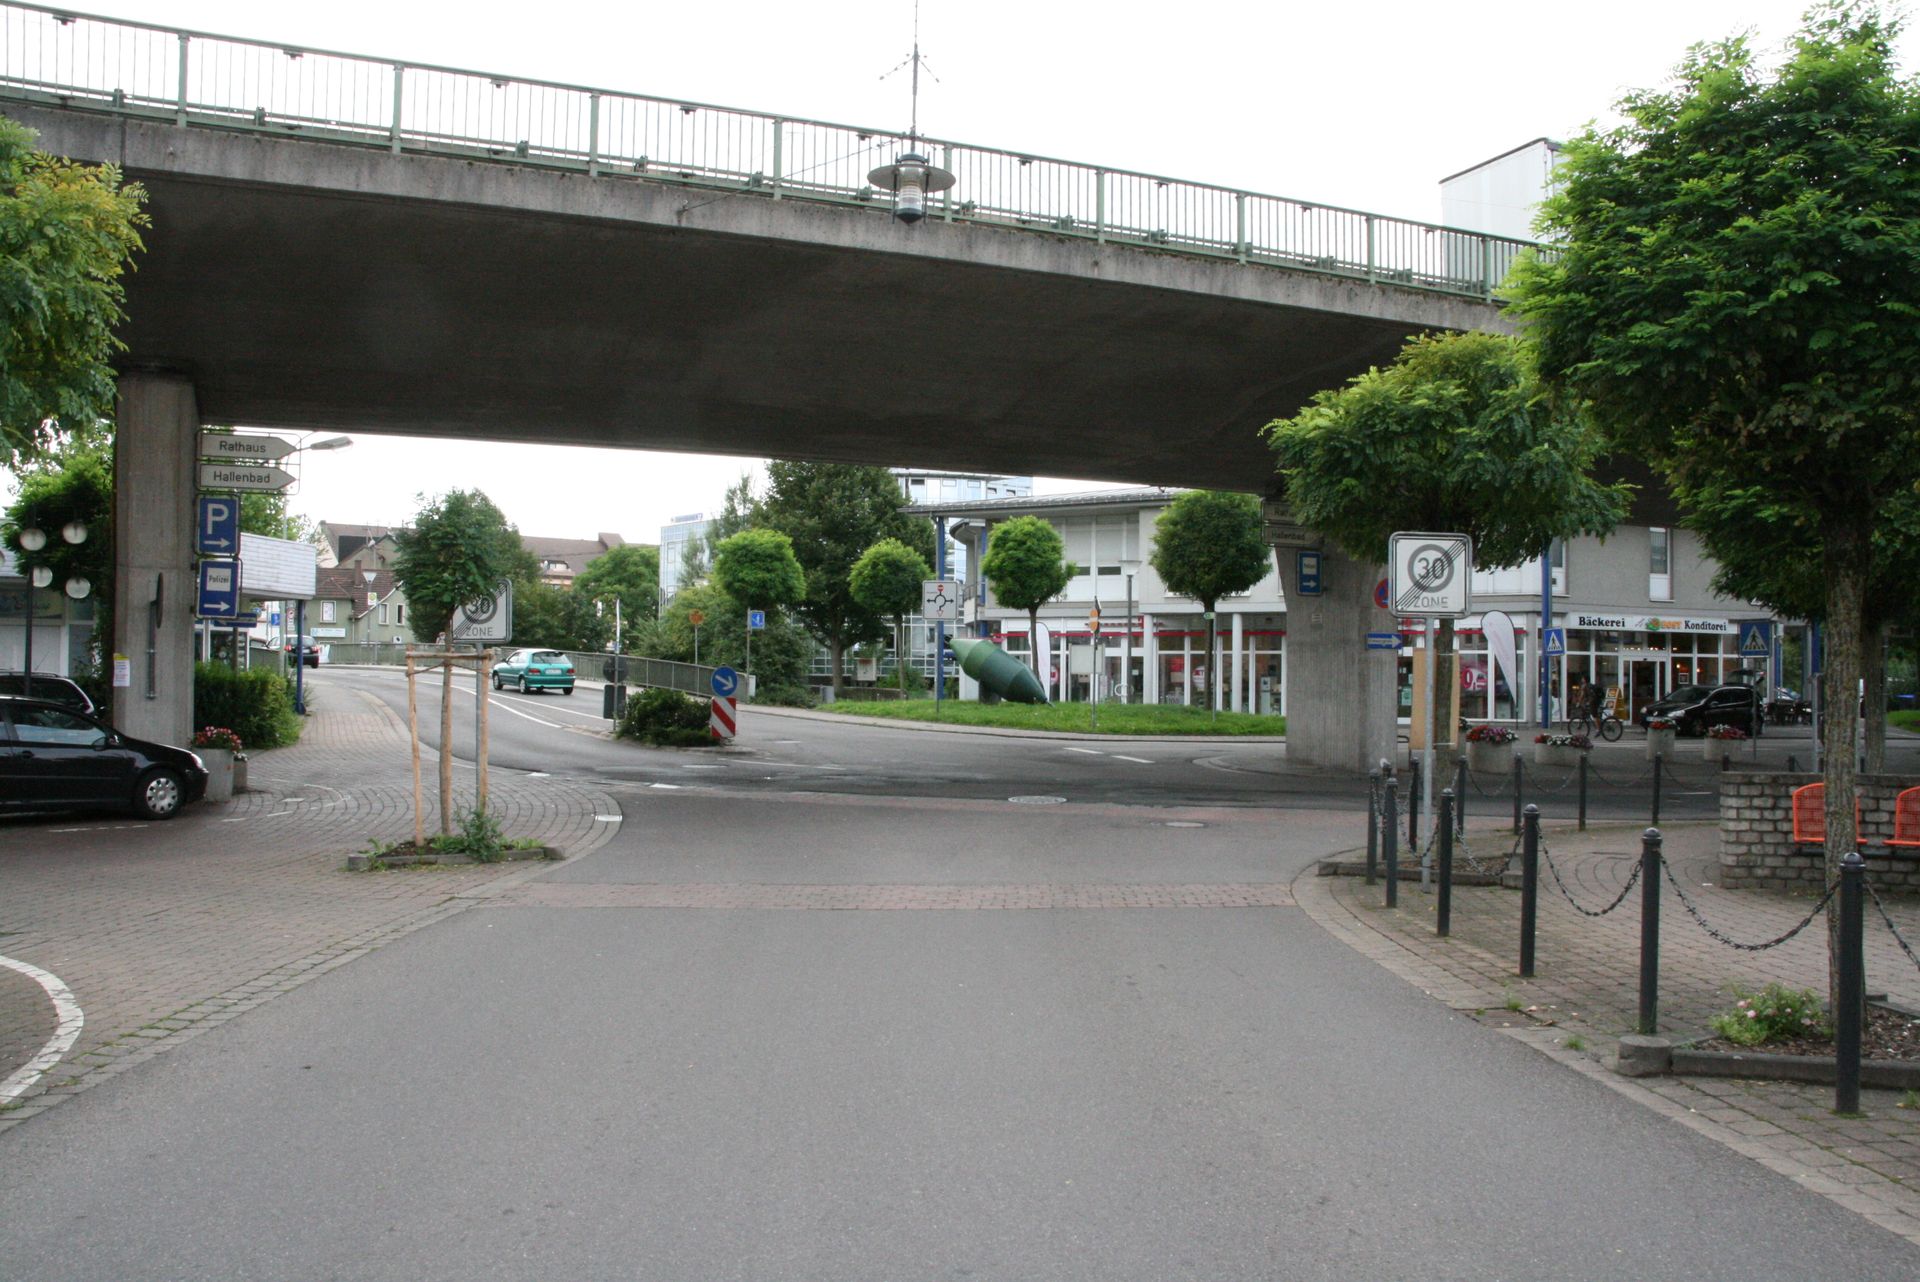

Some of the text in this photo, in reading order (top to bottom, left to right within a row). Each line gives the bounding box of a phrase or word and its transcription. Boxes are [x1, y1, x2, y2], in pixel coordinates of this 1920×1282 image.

[219, 440, 266, 453] Rathaus
[213, 471, 271, 483] Hallenbad
[207, 503, 229, 535] P
[1417, 557, 1444, 580] 30
[208, 575, 229, 583] Polizei
[1413, 596, 1449, 609] ZONE
[1578, 616, 1626, 628] Bäckerei
[1684, 620, 1727, 631] Konditorei
[466, 627, 493, 637] ZONE
